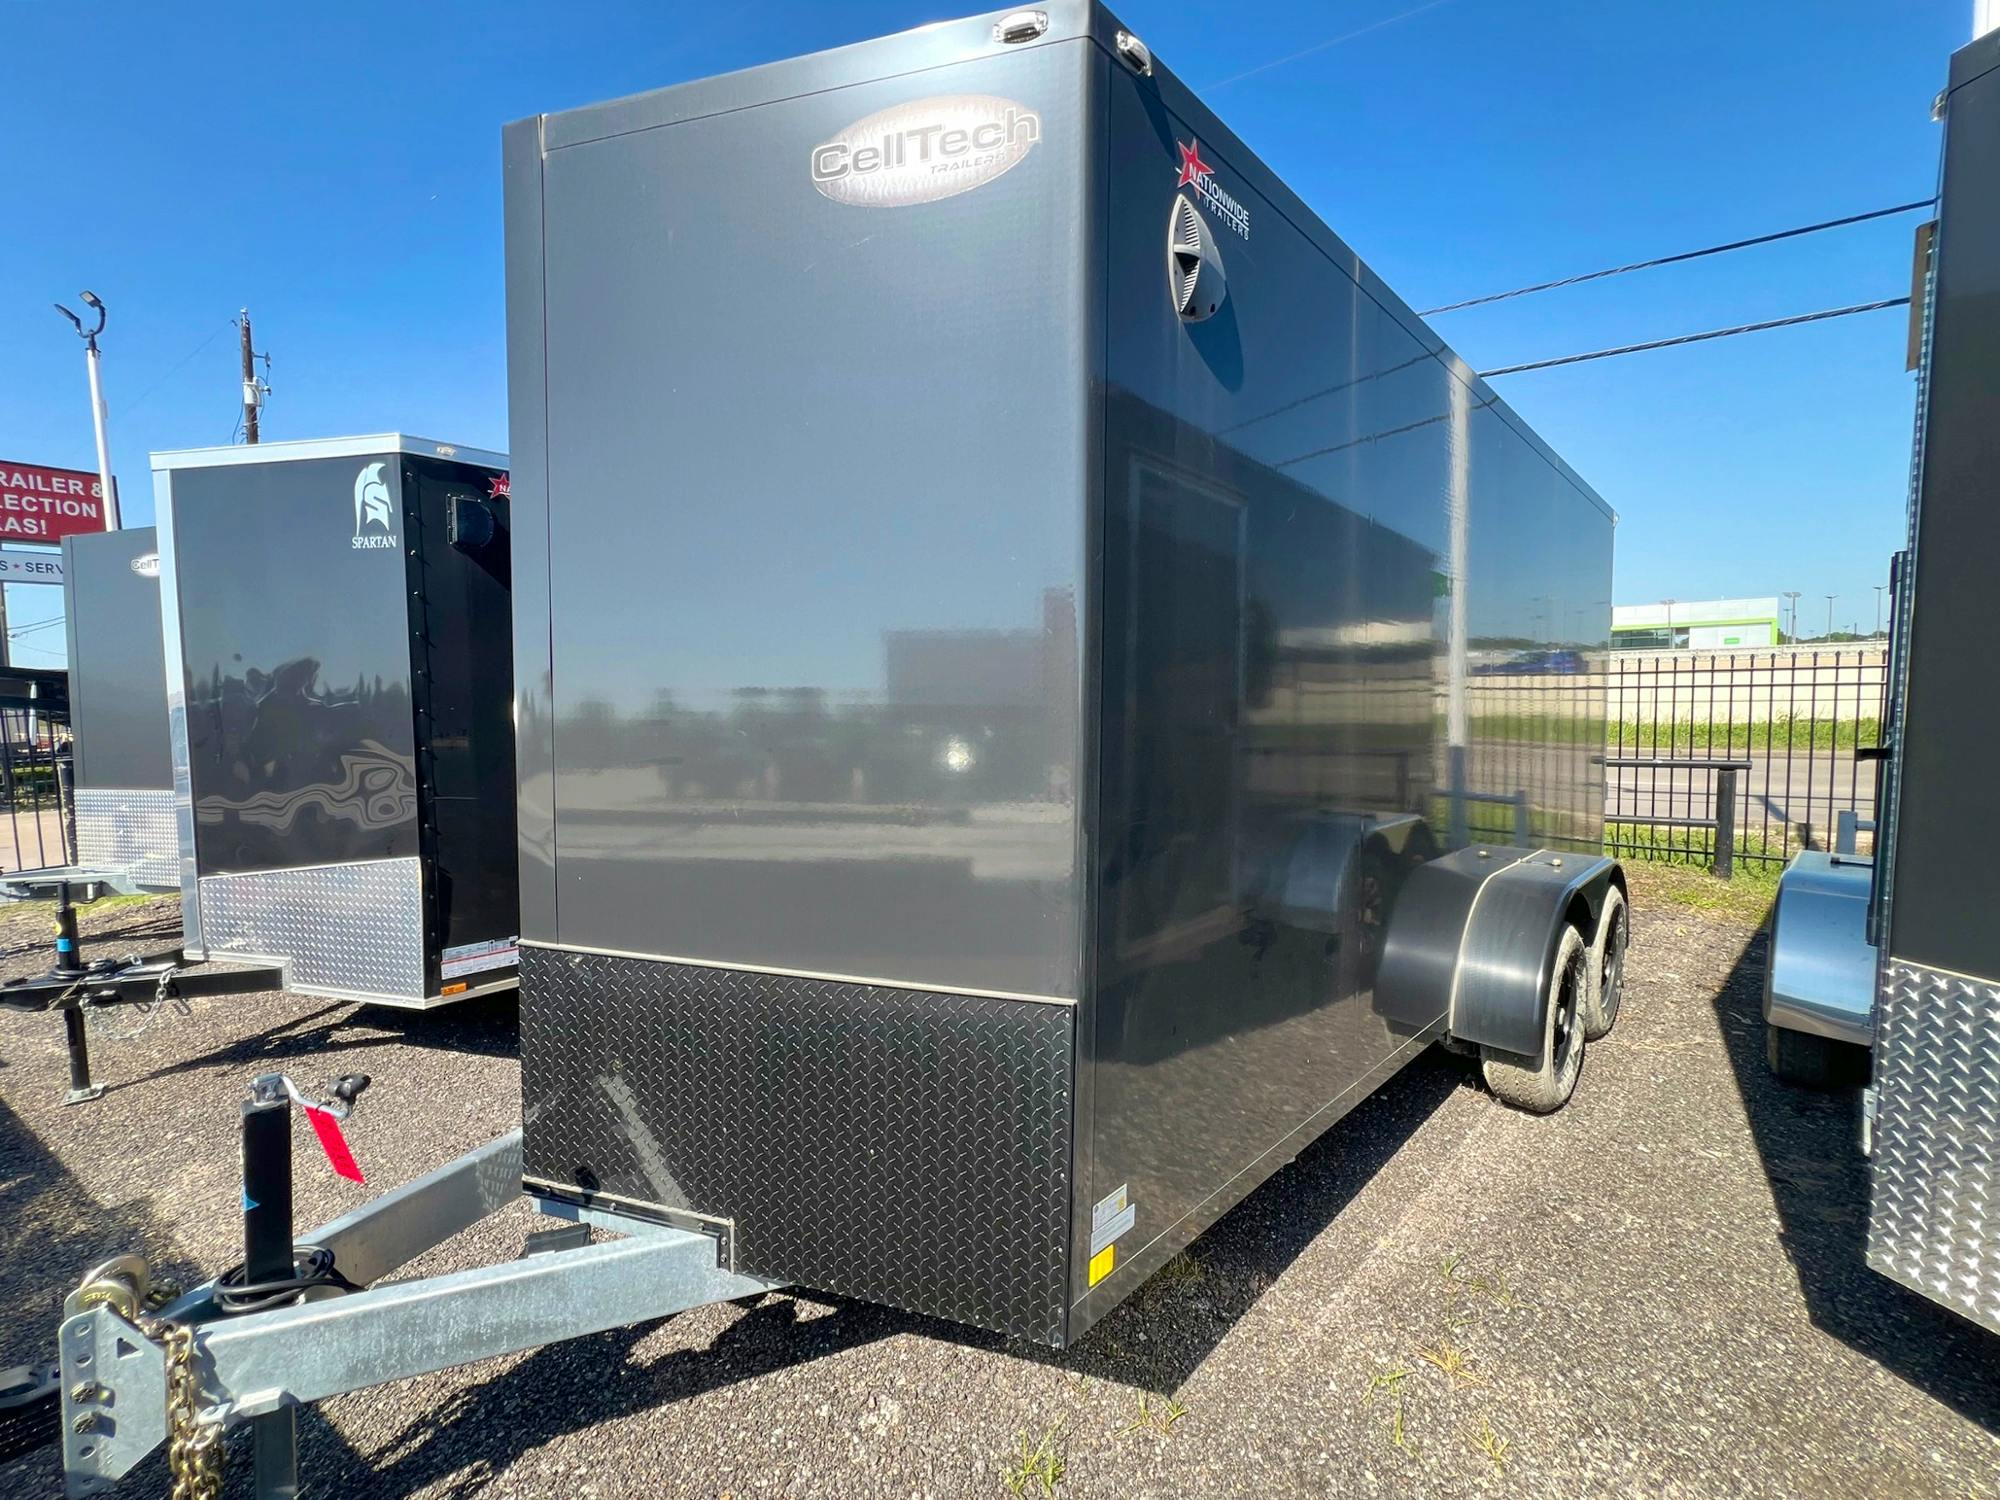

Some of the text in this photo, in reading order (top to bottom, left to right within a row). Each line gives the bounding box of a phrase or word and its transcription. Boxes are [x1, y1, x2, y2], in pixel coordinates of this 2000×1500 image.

[812, 108, 1039, 181] CellTech
[1189, 163, 1250, 226] NATIONWIDE
[1203, 195, 1250, 240] TRAILERS
[90, 482, 103, 498] &
[0, 494, 97, 518] ECTION
[0, 516, 47, 535] AS!
[352, 535, 398, 550] SPARTAN
